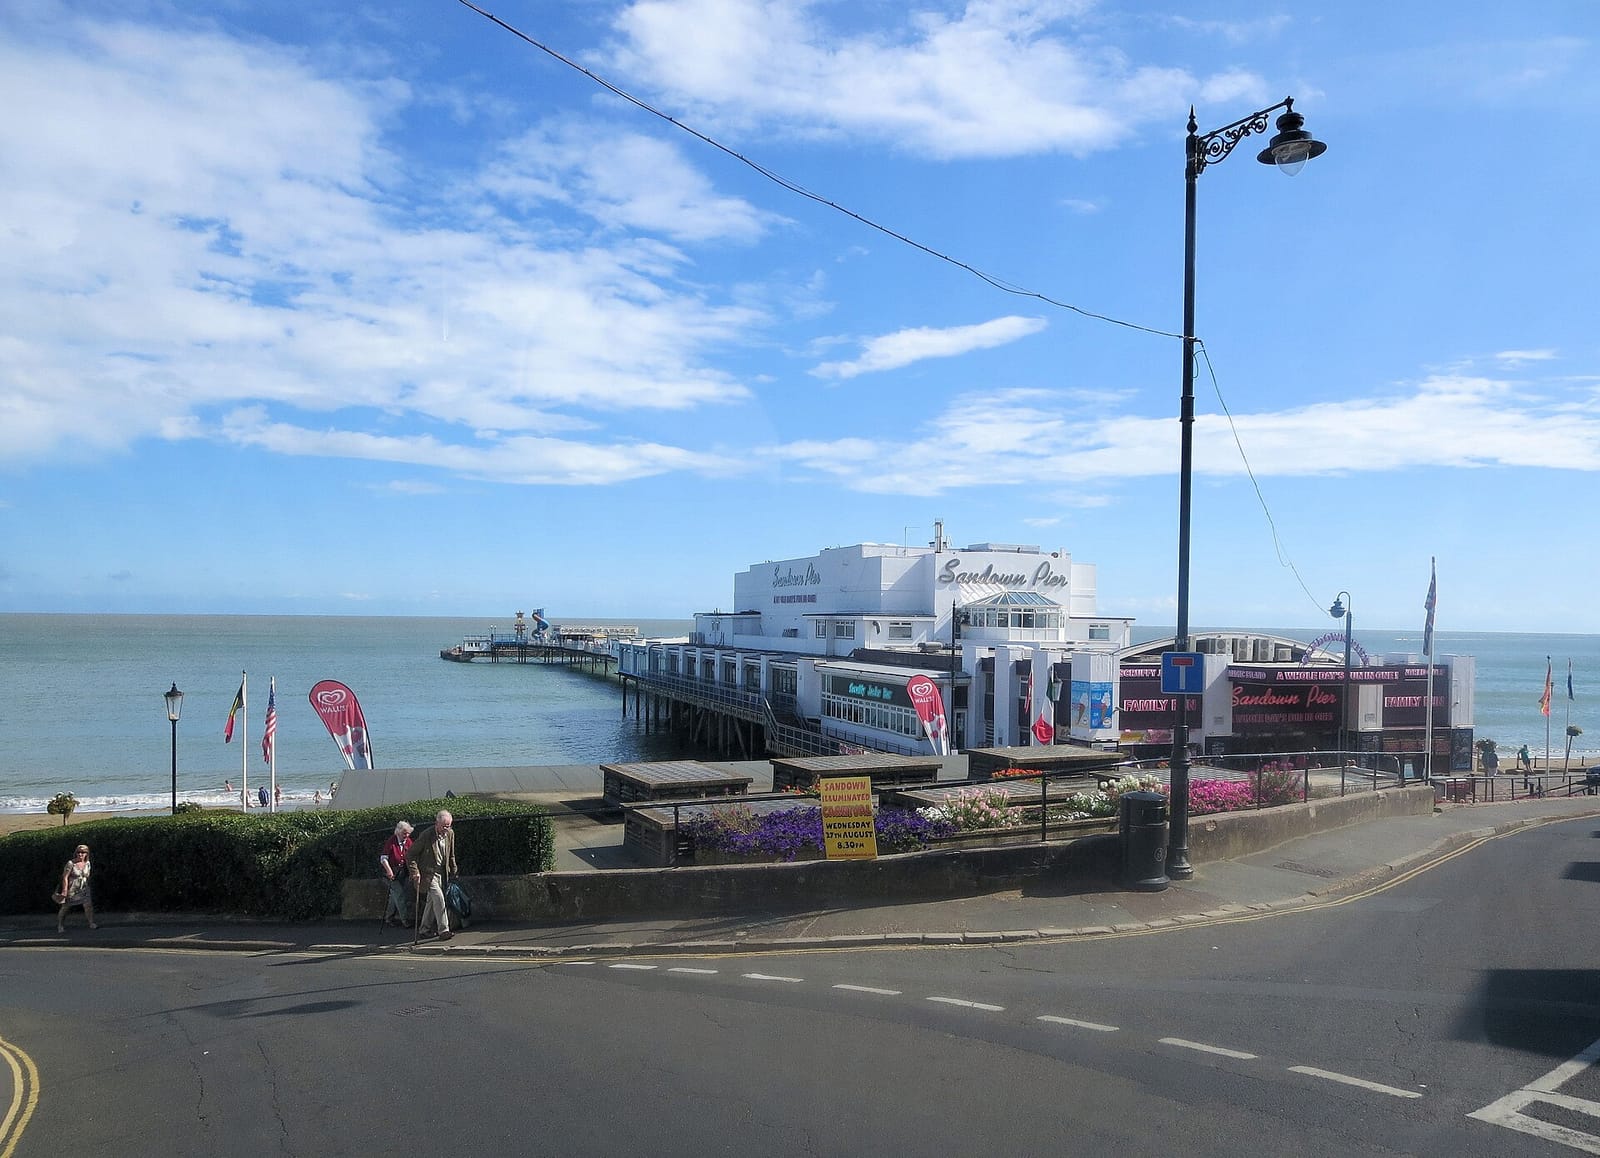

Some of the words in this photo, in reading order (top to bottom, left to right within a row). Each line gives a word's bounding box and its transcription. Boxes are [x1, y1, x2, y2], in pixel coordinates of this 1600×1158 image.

[772, 564, 804, 588] Sandown
[938, 558, 1027, 585] Sandown
[1032, 560, 1069, 587] Pier
[1285, 671, 1318, 680] WHOLE
[1231, 686, 1300, 707] Sandown
[1305, 684, 1337, 708] Pier
[1384, 696, 1423, 708] FAMILY
[1123, 699, 1169, 712] FAMILY
[824, 781, 866, 791] SANDOWN
[822, 793, 871, 803] ILLUMINATED
[826, 821, 871, 830] WEDNESDAY
